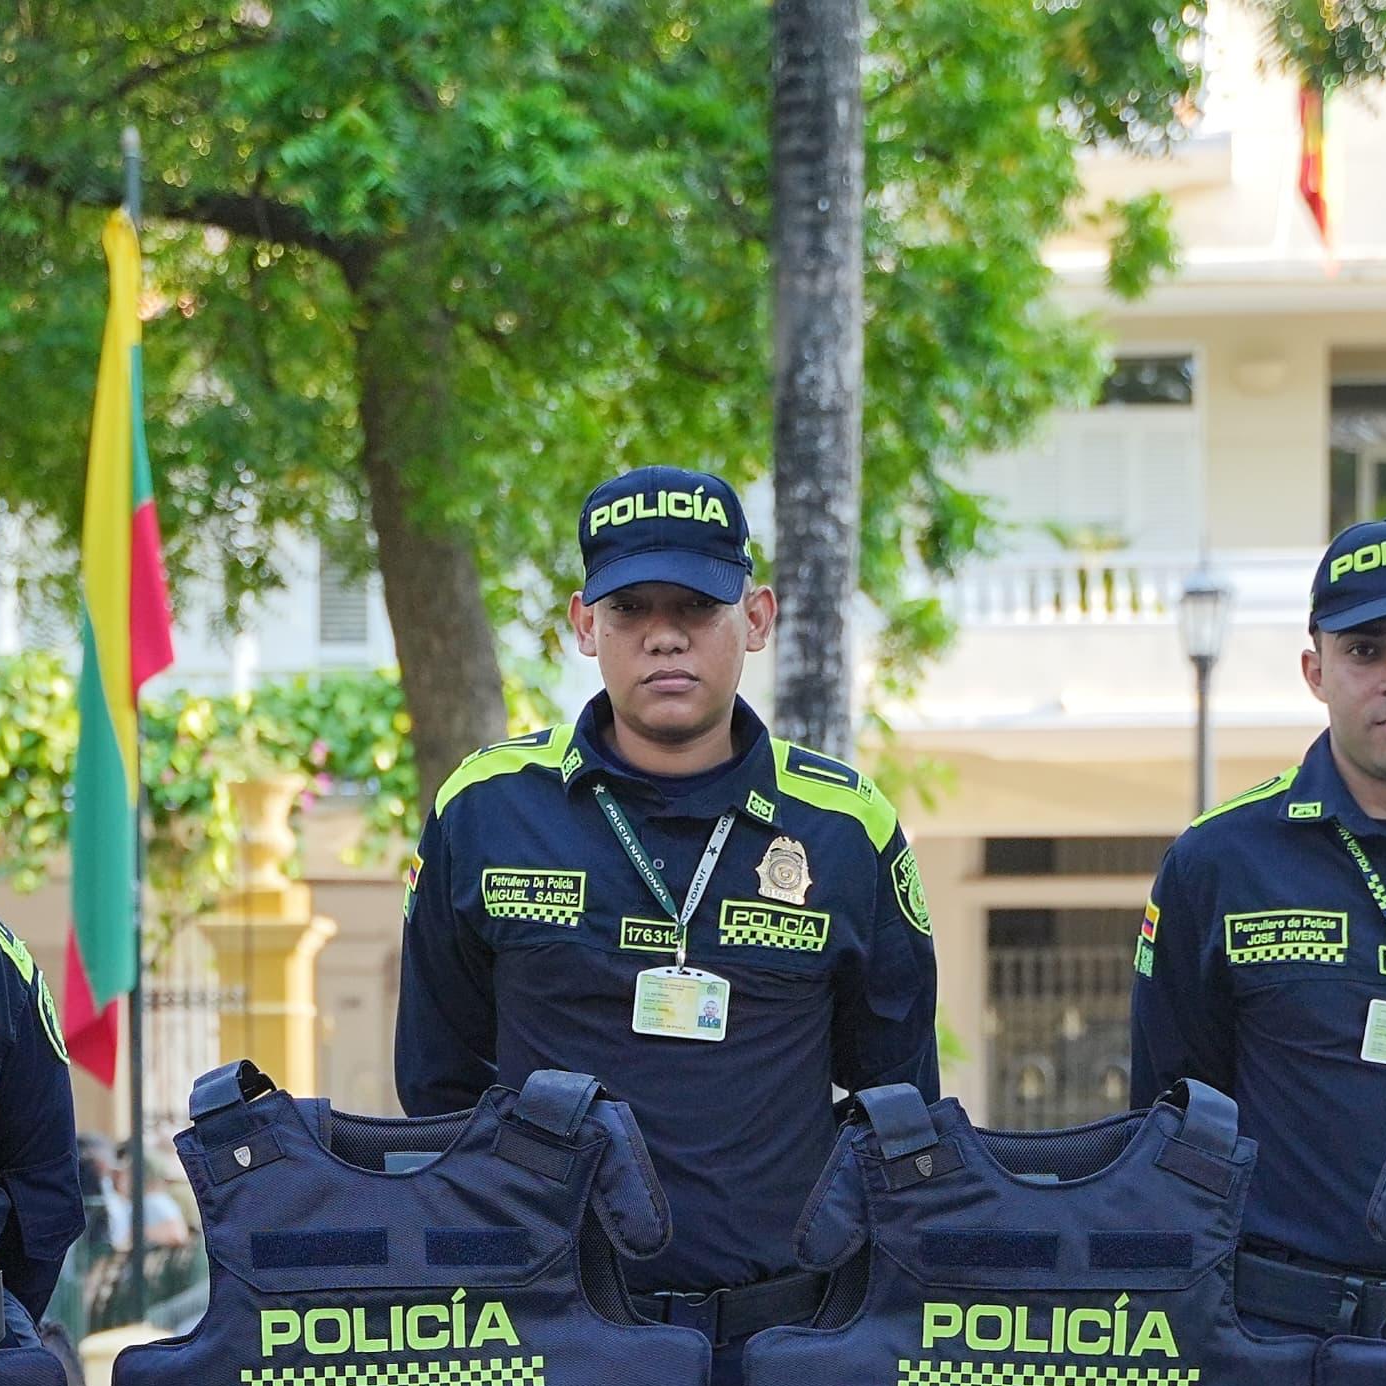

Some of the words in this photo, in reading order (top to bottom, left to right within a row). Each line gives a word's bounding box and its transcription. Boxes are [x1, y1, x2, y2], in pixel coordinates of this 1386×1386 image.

[590, 484, 729, 537] POLICÍA
[487, 888, 530, 902] MIGUEL
[534, 890, 579, 904] SAENZ
[629, 845, 668, 903] NACIONAL
[732, 910, 818, 937] POLICÍA
[1246, 932, 1275, 946] JOSE
[1282, 930, 1326, 942] RIVERA
[259, 1287, 520, 1358] POLICÍA
[921, 1293, 1179, 1358] POLICÍA
